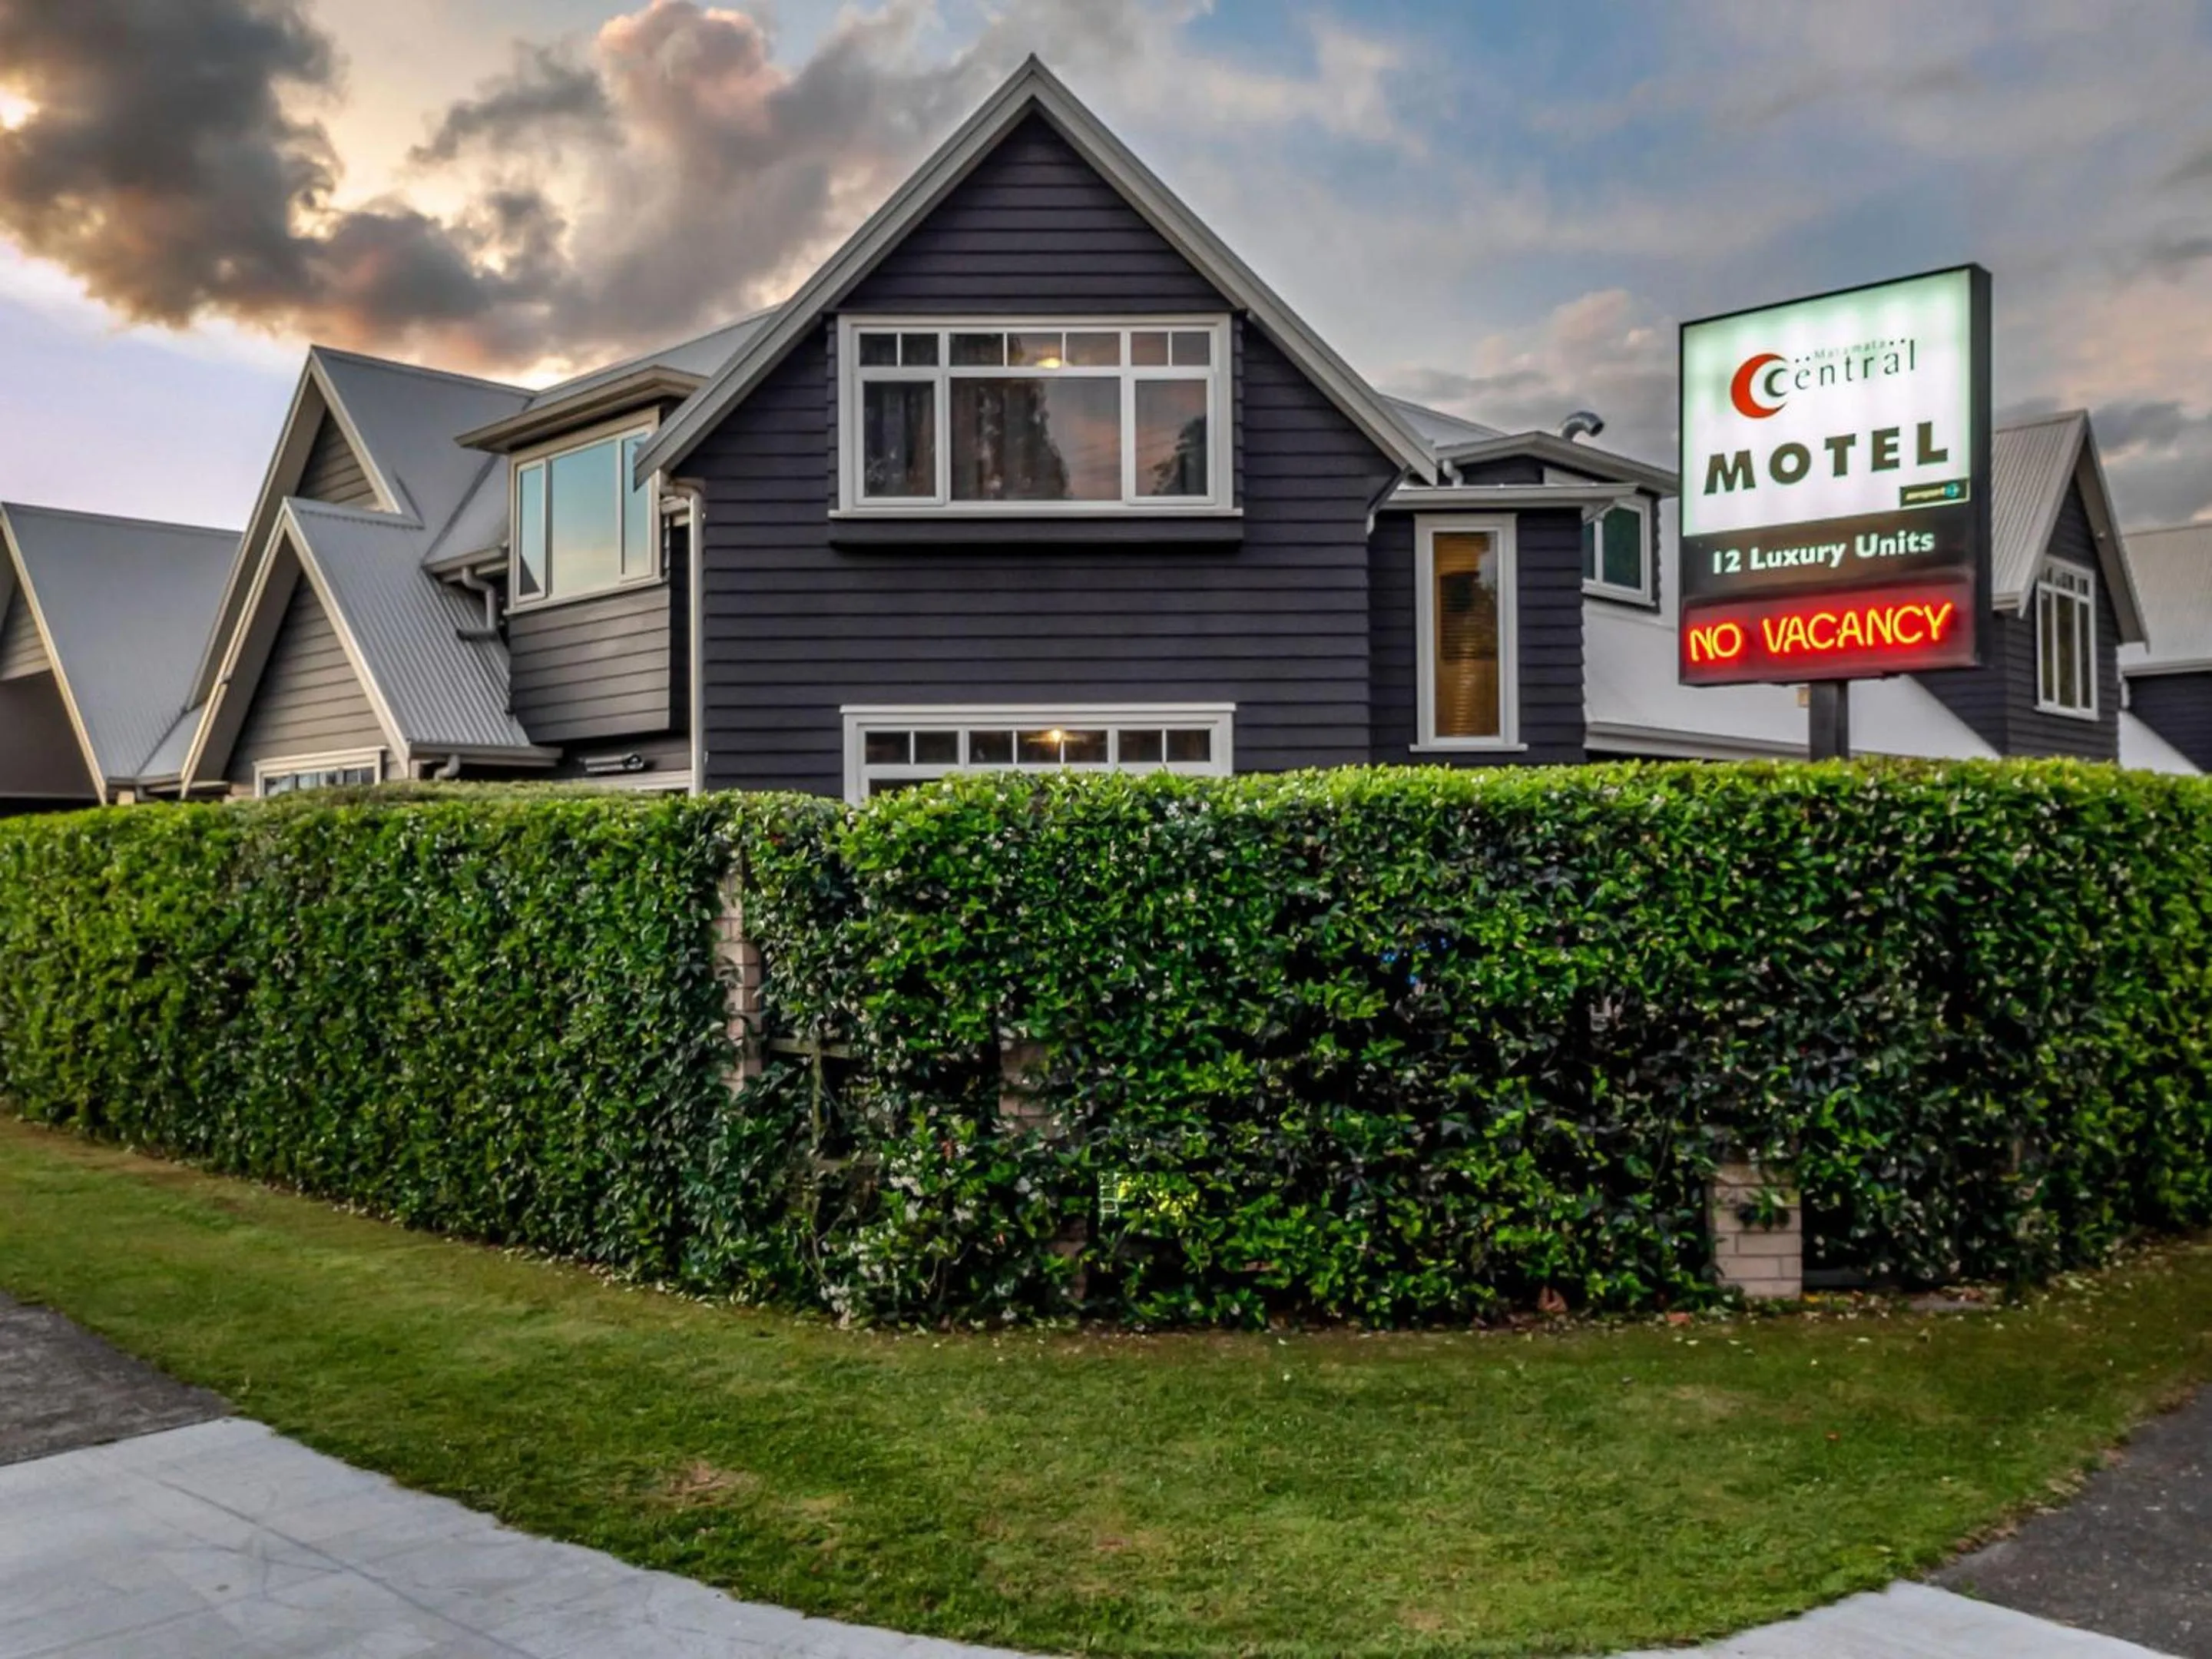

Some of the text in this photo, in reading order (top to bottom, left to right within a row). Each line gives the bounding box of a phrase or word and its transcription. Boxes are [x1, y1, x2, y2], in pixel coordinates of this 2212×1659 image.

[1764, 339, 1916, 397] Central
[1703, 421, 1949, 495] MOTEL
[1712, 529, 1936, 575] 12 Luxury Units
[1690, 601, 1953, 662] NO VACANCY
